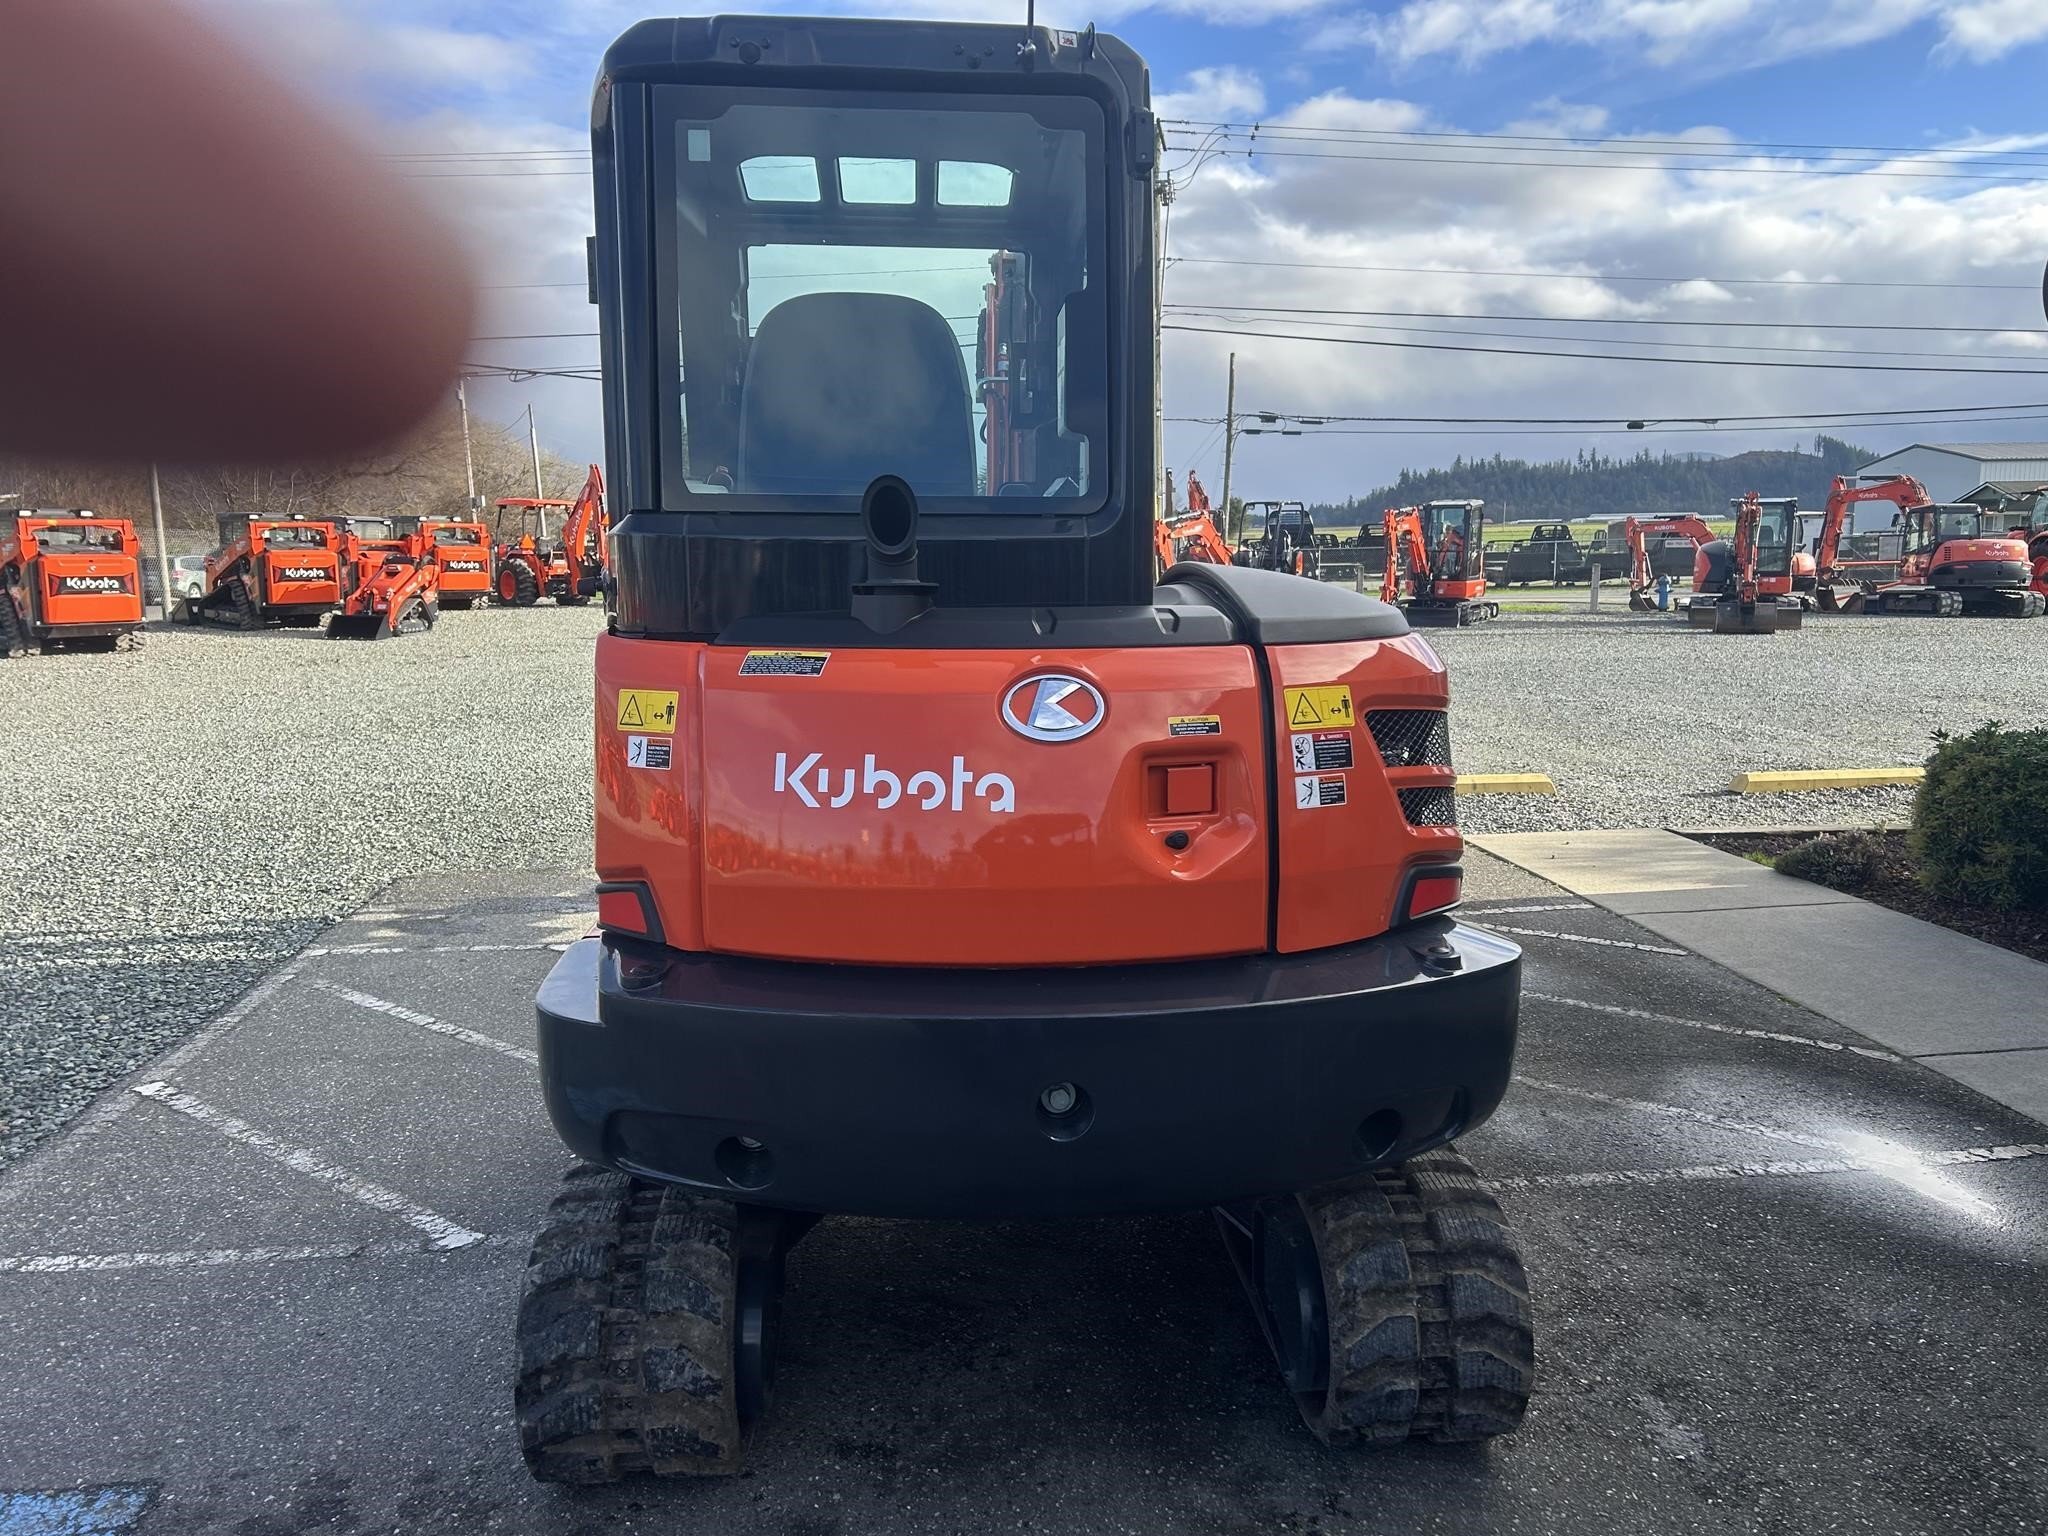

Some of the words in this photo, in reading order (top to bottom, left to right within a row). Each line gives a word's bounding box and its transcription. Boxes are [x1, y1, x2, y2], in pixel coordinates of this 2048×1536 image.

[449, 560, 480, 569] Kubota
[285, 567, 325, 578] Kubota
[66, 577, 119, 589] Kubota
[774, 752, 1015, 813] Kubota
